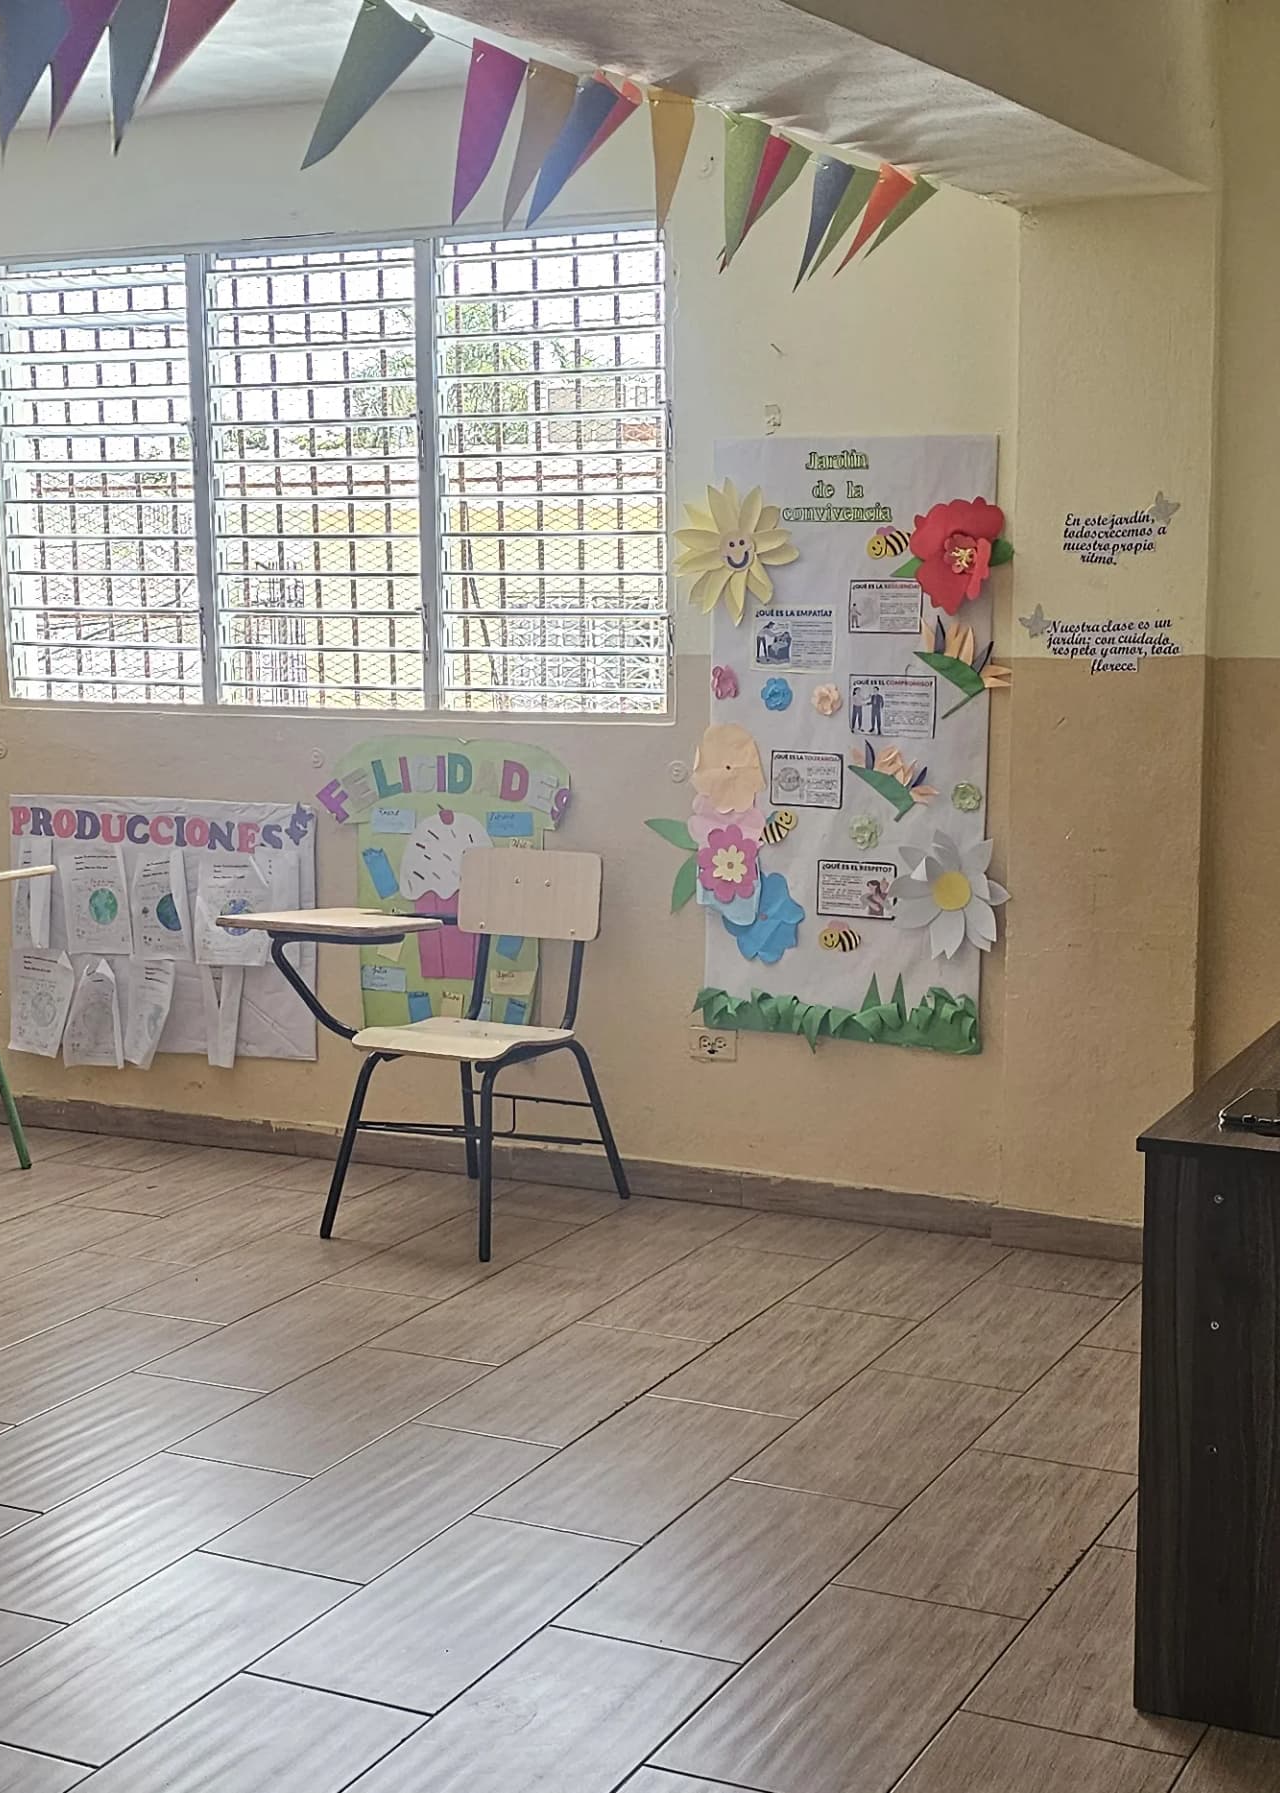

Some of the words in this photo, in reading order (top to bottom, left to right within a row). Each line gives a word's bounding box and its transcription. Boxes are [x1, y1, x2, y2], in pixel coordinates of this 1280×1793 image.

[805, 449, 869, 470] Jardín
[812, 480, 835, 499] de
[846, 480, 864, 498] la
[782, 503, 893, 522] convivencia
[1065, 513, 1081, 526] En
[1157, 526, 1168, 536] a
[1111, 540, 1155, 555] propio
[1080, 552, 1118, 566] ritmo.
[755, 608, 774, 618] ¿QUÉ
[796, 608, 833, 617] EMPATÍA?
[1047, 620, 1100, 634] Nuestra
[1101, 619, 1135, 632] clase
[1137, 620, 1150, 630] es
[1154, 618, 1173, 629] un
[1094, 635, 1116, 646] con
[1052, 644, 1097, 659] respeto
[1100, 646, 1111, 658] y
[1109, 645, 1148, 657] amor,
[1151, 643, 1180, 656] todo
[1090, 658, 1137, 675] florece.
[315, 752, 571, 824] FELICIDADES
[11, 806, 284, 854] PRODUCCIONES
[822, 862, 840, 870] ¿QUÉ
